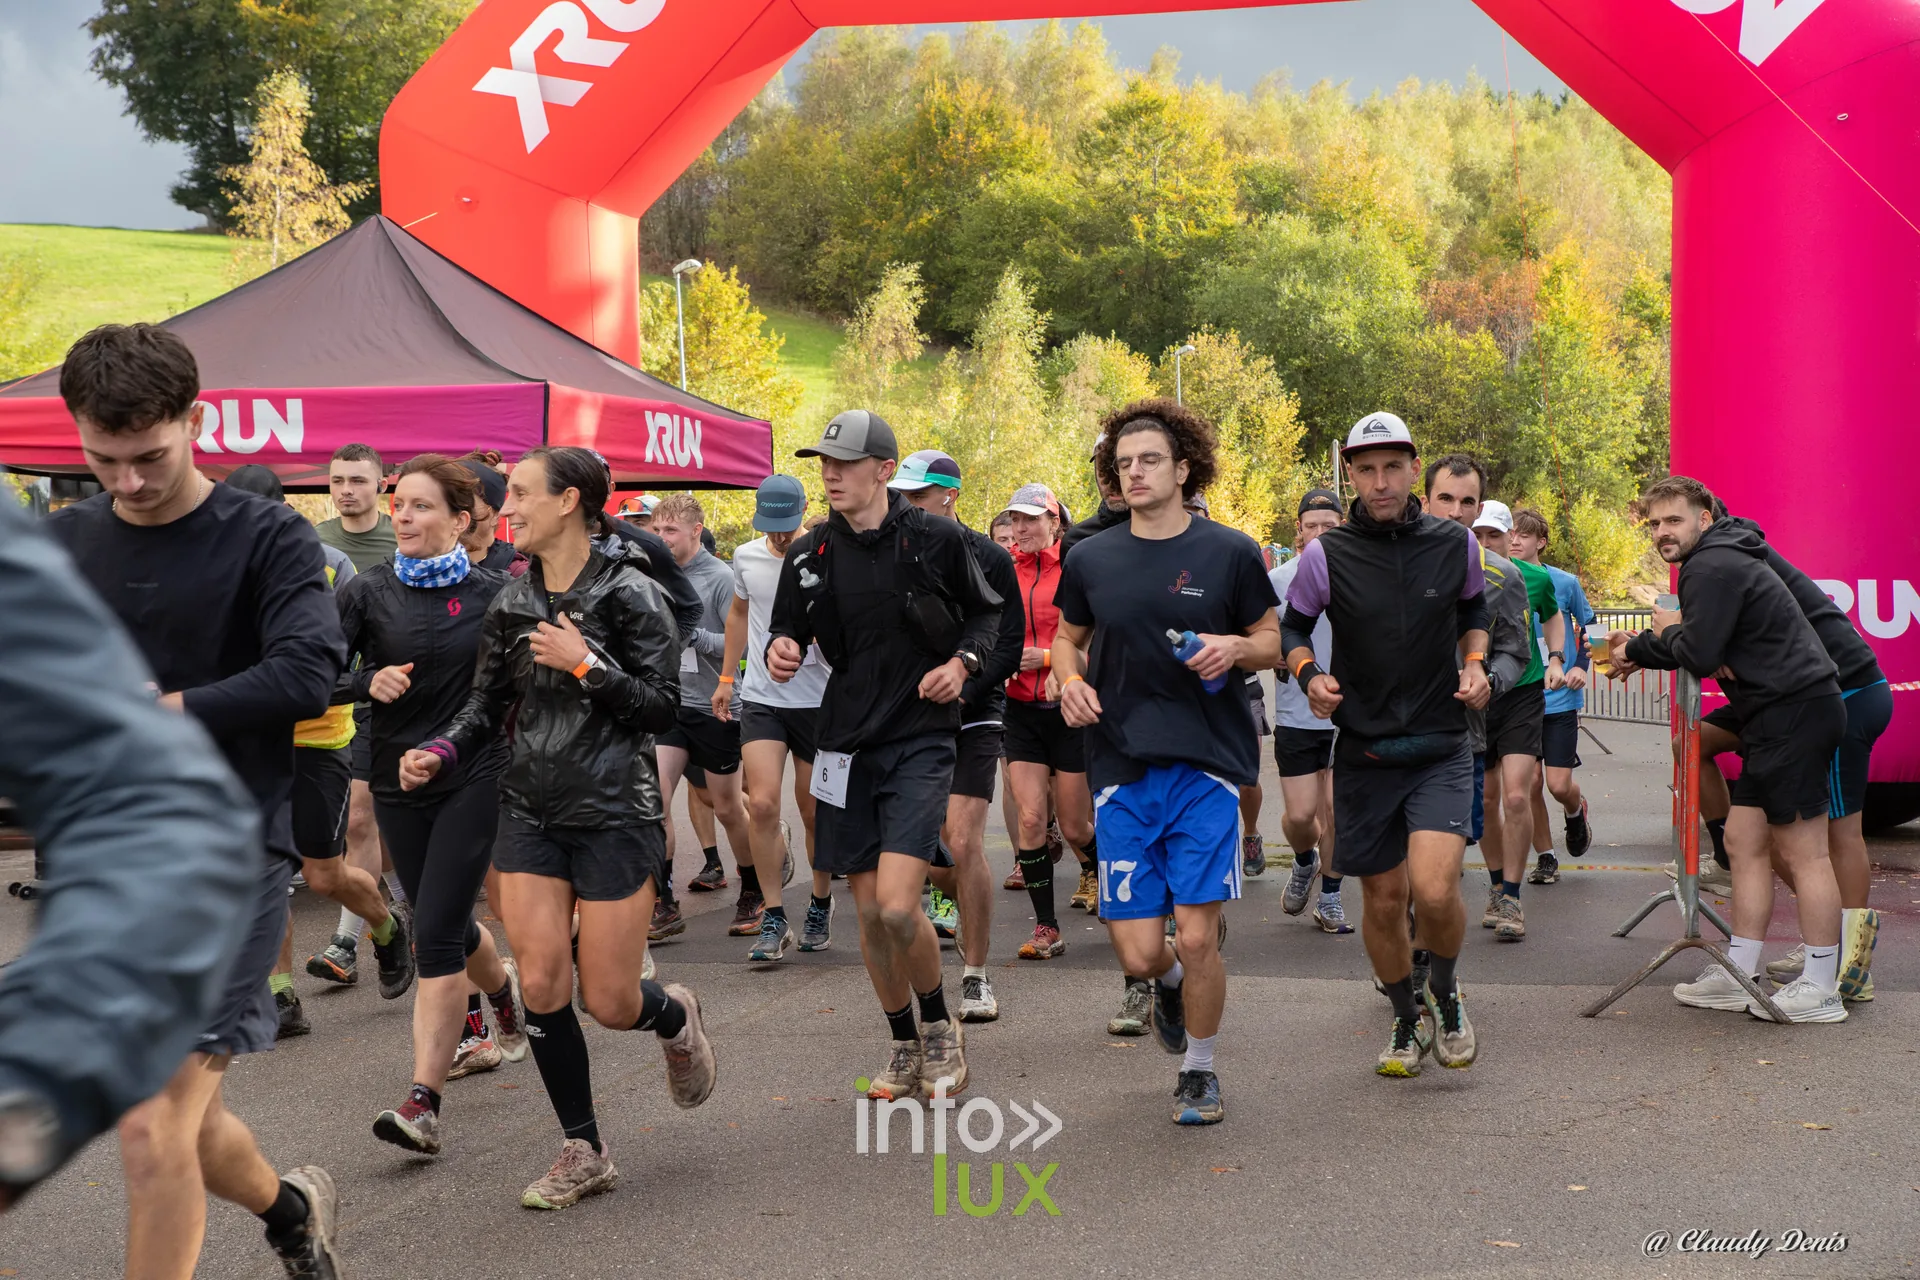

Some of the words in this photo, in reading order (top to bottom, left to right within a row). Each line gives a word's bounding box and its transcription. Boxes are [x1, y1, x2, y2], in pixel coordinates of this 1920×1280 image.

[191, 398, 304, 454] RUN
[644, 410, 703, 469] XRUN
[569, 611, 584, 621] GORE
[822, 767, 829, 783] 6
[1098, 860, 1137, 902] 17
[1820, 994, 1842, 1009] HOKA
